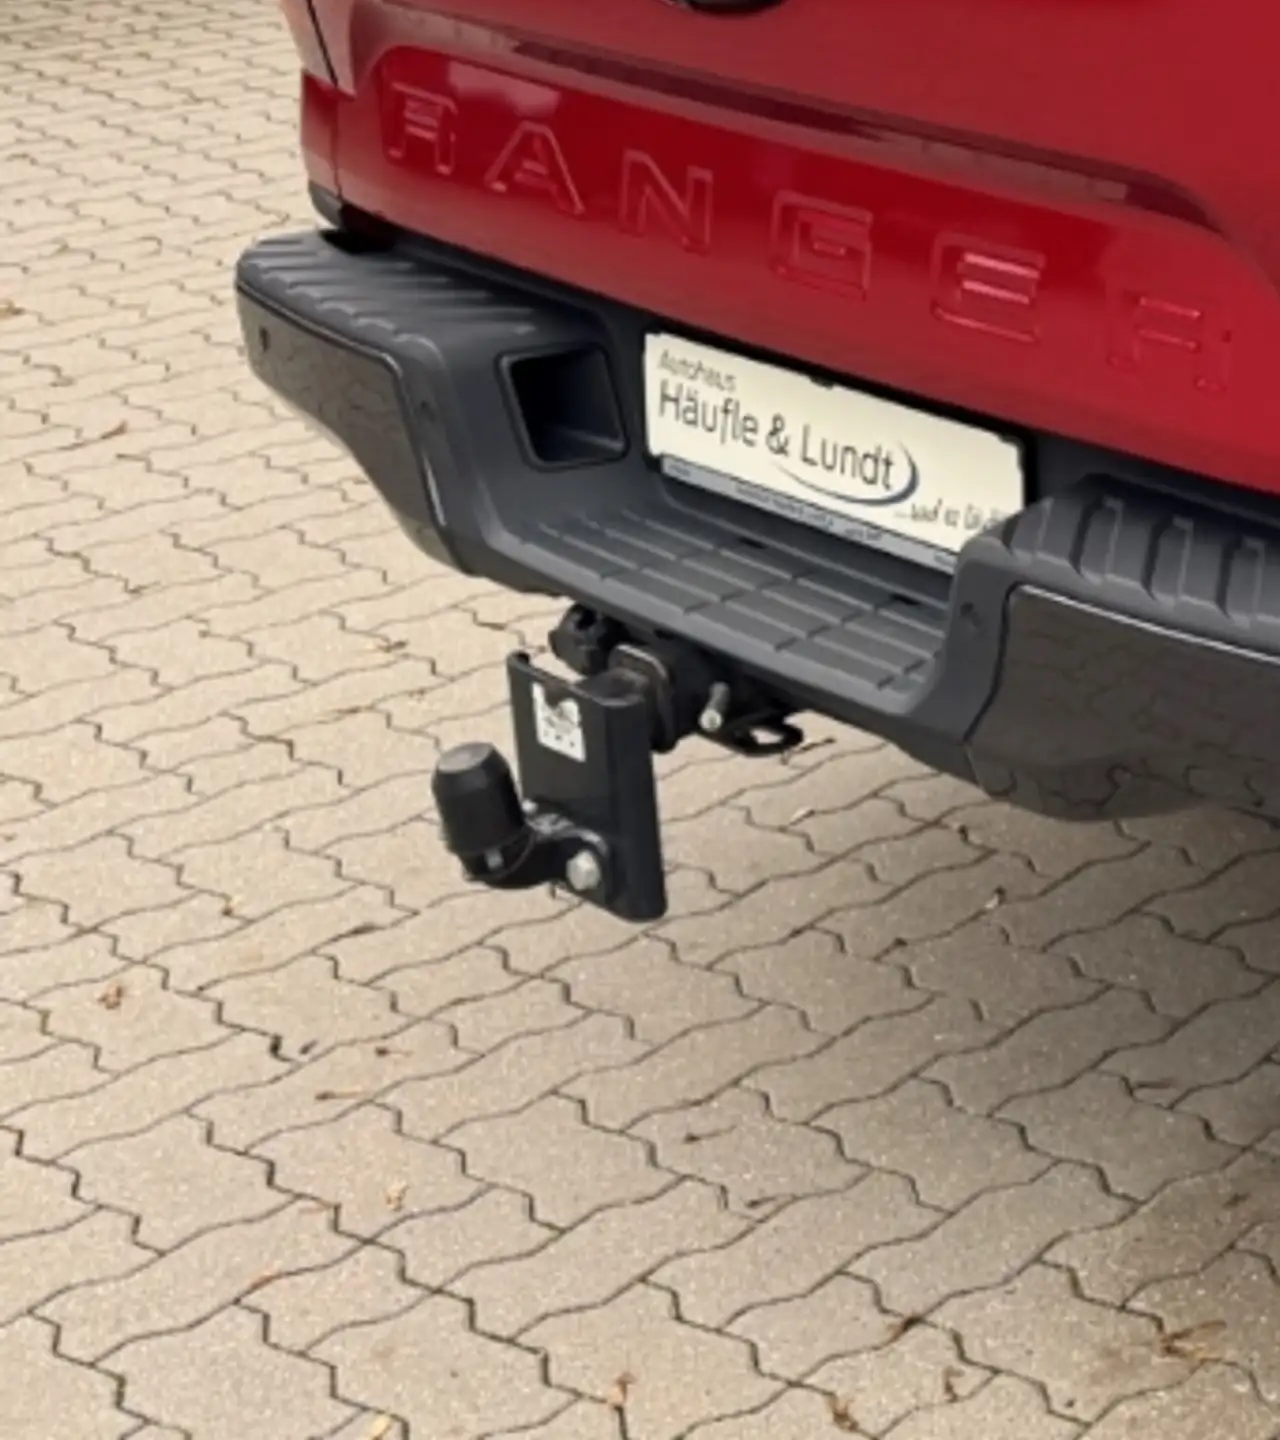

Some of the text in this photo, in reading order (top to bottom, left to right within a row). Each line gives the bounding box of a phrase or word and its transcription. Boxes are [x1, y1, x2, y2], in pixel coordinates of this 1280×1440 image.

[387, 82, 1238, 394] RANGER
[658, 349, 737, 393] Autohaus
[658, 378, 896, 491] Häufle & Lundt
